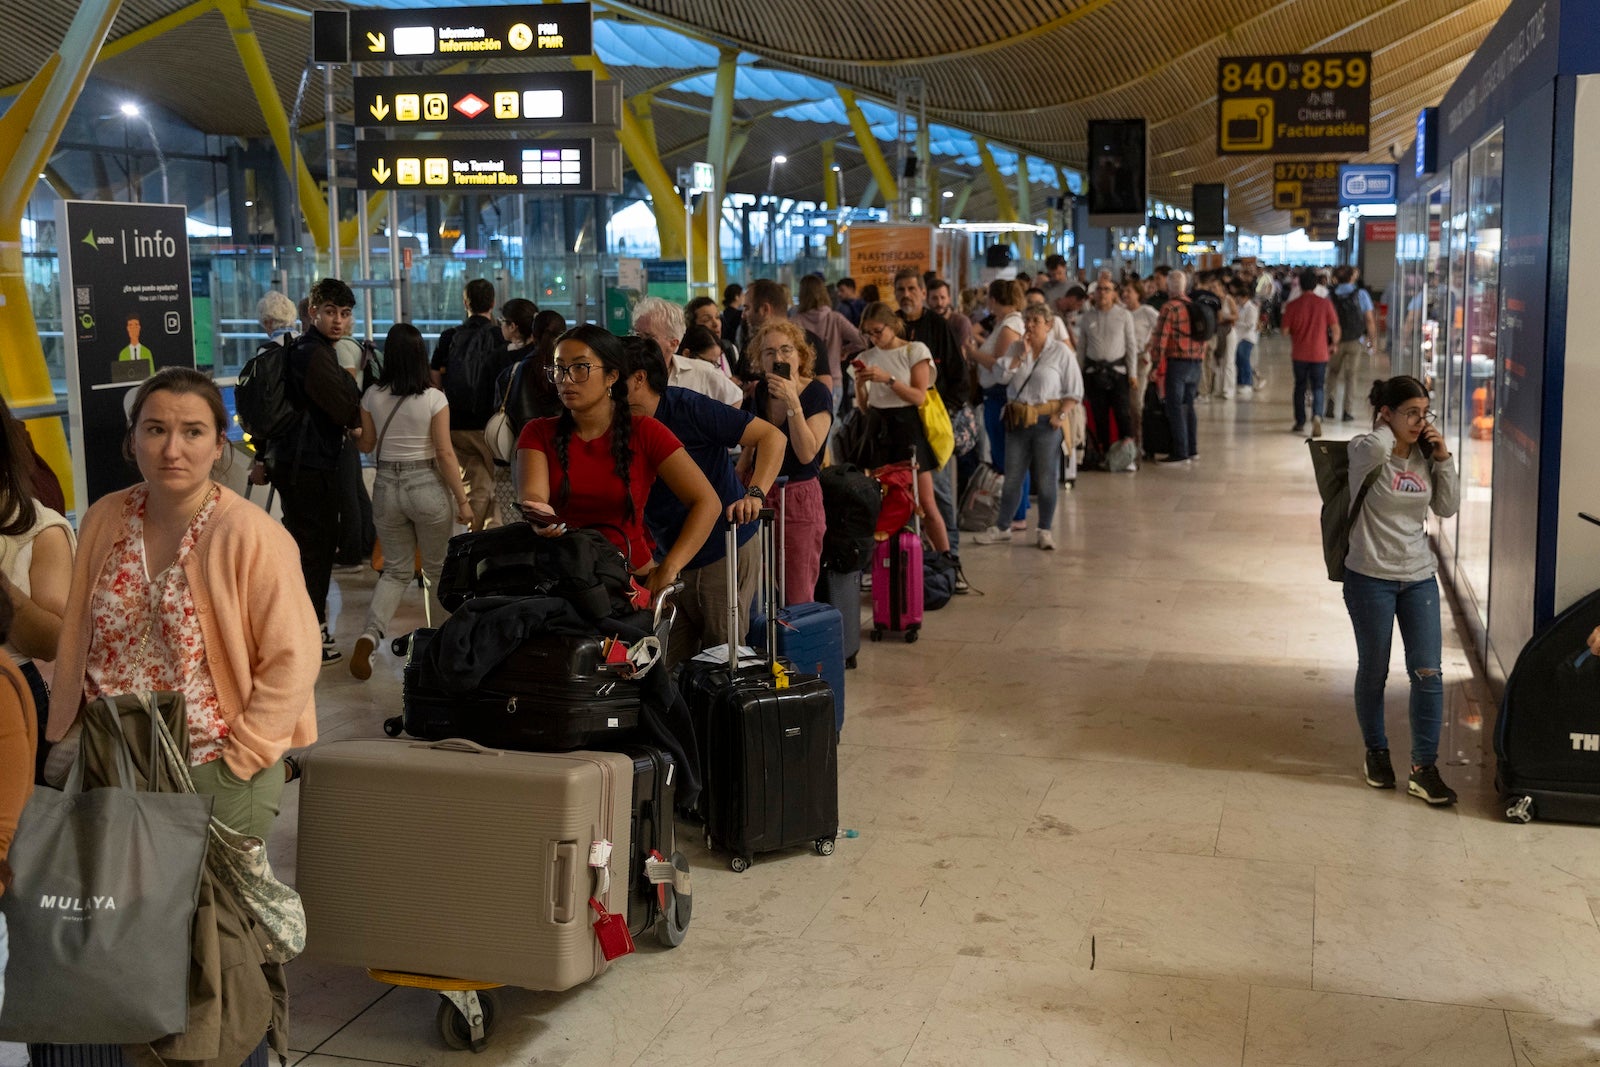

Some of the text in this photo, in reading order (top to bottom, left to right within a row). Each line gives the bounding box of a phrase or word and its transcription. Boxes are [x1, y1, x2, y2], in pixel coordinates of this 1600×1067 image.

[439, 26, 485, 38] Information
[439, 38, 501, 52] Información
[538, 35, 564, 48] PMR
[1222, 58, 1367, 92] 840 to 859
[1289, 79, 1299, 90] a
[1297, 108, 1347, 121] Check-in
[1277, 122, 1366, 138] Facturación
[453, 160, 504, 171] Bus Terminal
[1276, 164, 1308, 180] 870
[1315, 163, 1340, 179] 88
[453, 172, 518, 185] Terminal Bus
[97, 229, 176, 258] aena info
[40, 895, 116, 911] MULAYA
